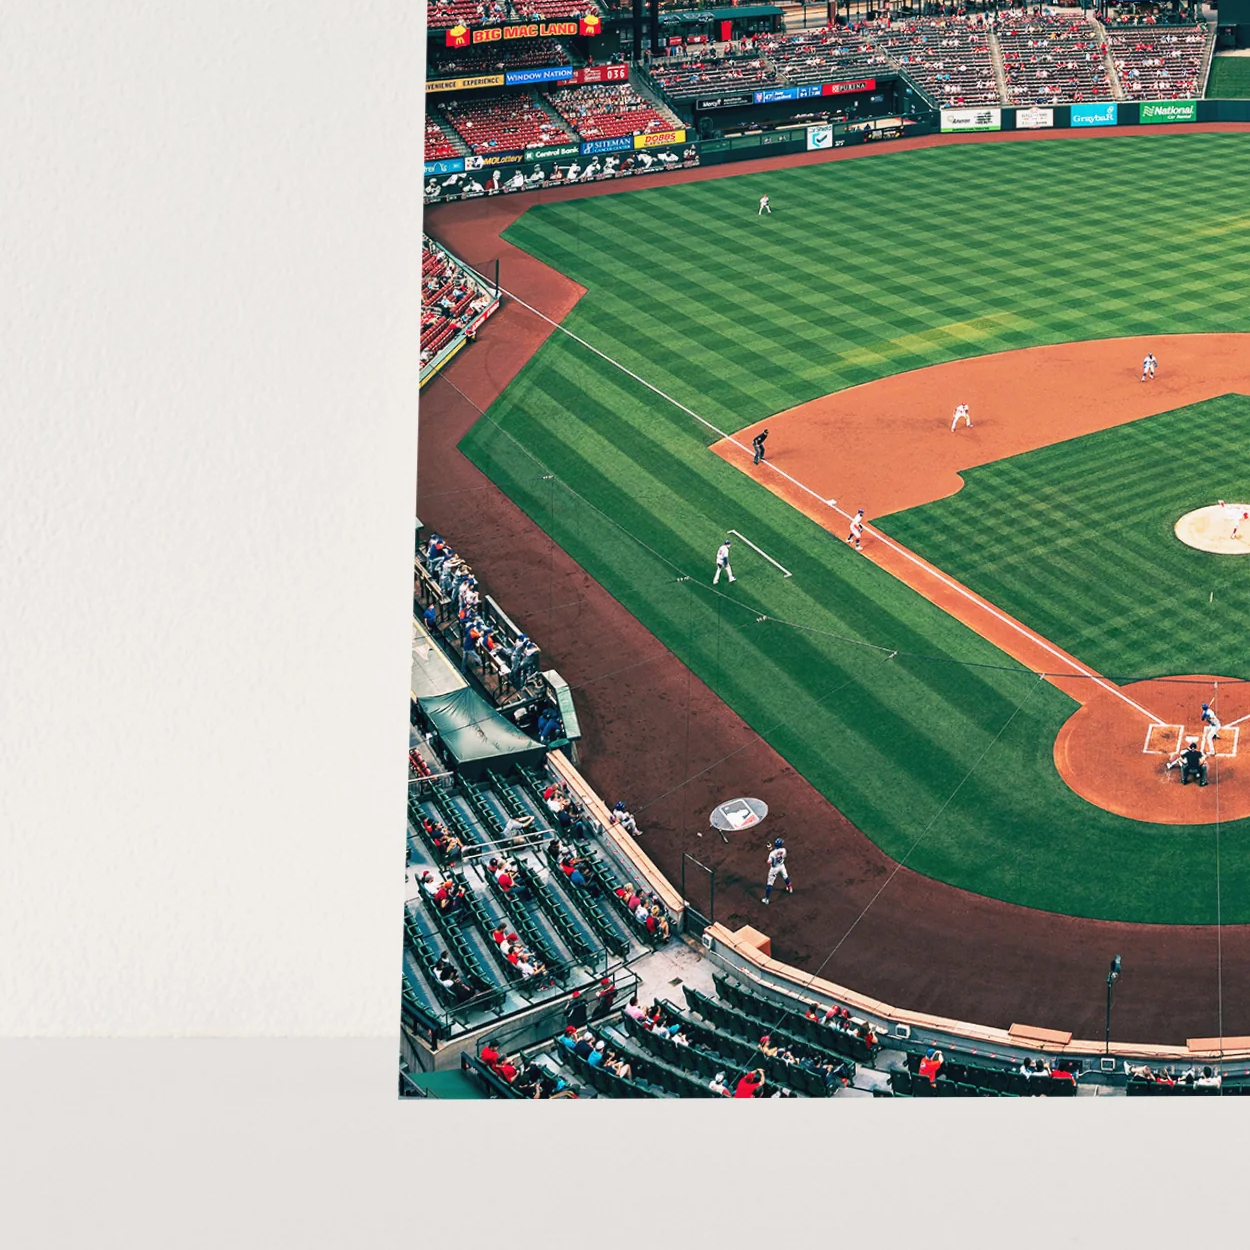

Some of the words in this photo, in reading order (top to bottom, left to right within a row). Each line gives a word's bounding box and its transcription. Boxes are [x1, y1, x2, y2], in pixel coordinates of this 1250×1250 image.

[473, 28, 502, 44] BIG
[503, 25, 539, 40] MAC
[540, 22, 578, 36] LAND
[507, 71, 541, 82] WINDOW
[543, 68, 573, 78] NATION
[607, 70, 625, 79] 036
[462, 77, 499, 86] EXPERIENCE
[1154, 105, 1194, 116] National
[645, 133, 676, 142] DOBBS
[595, 138, 631, 148] SITEMAN
[535, 148, 560, 159] Central
[561, 147, 579, 156] Bank
